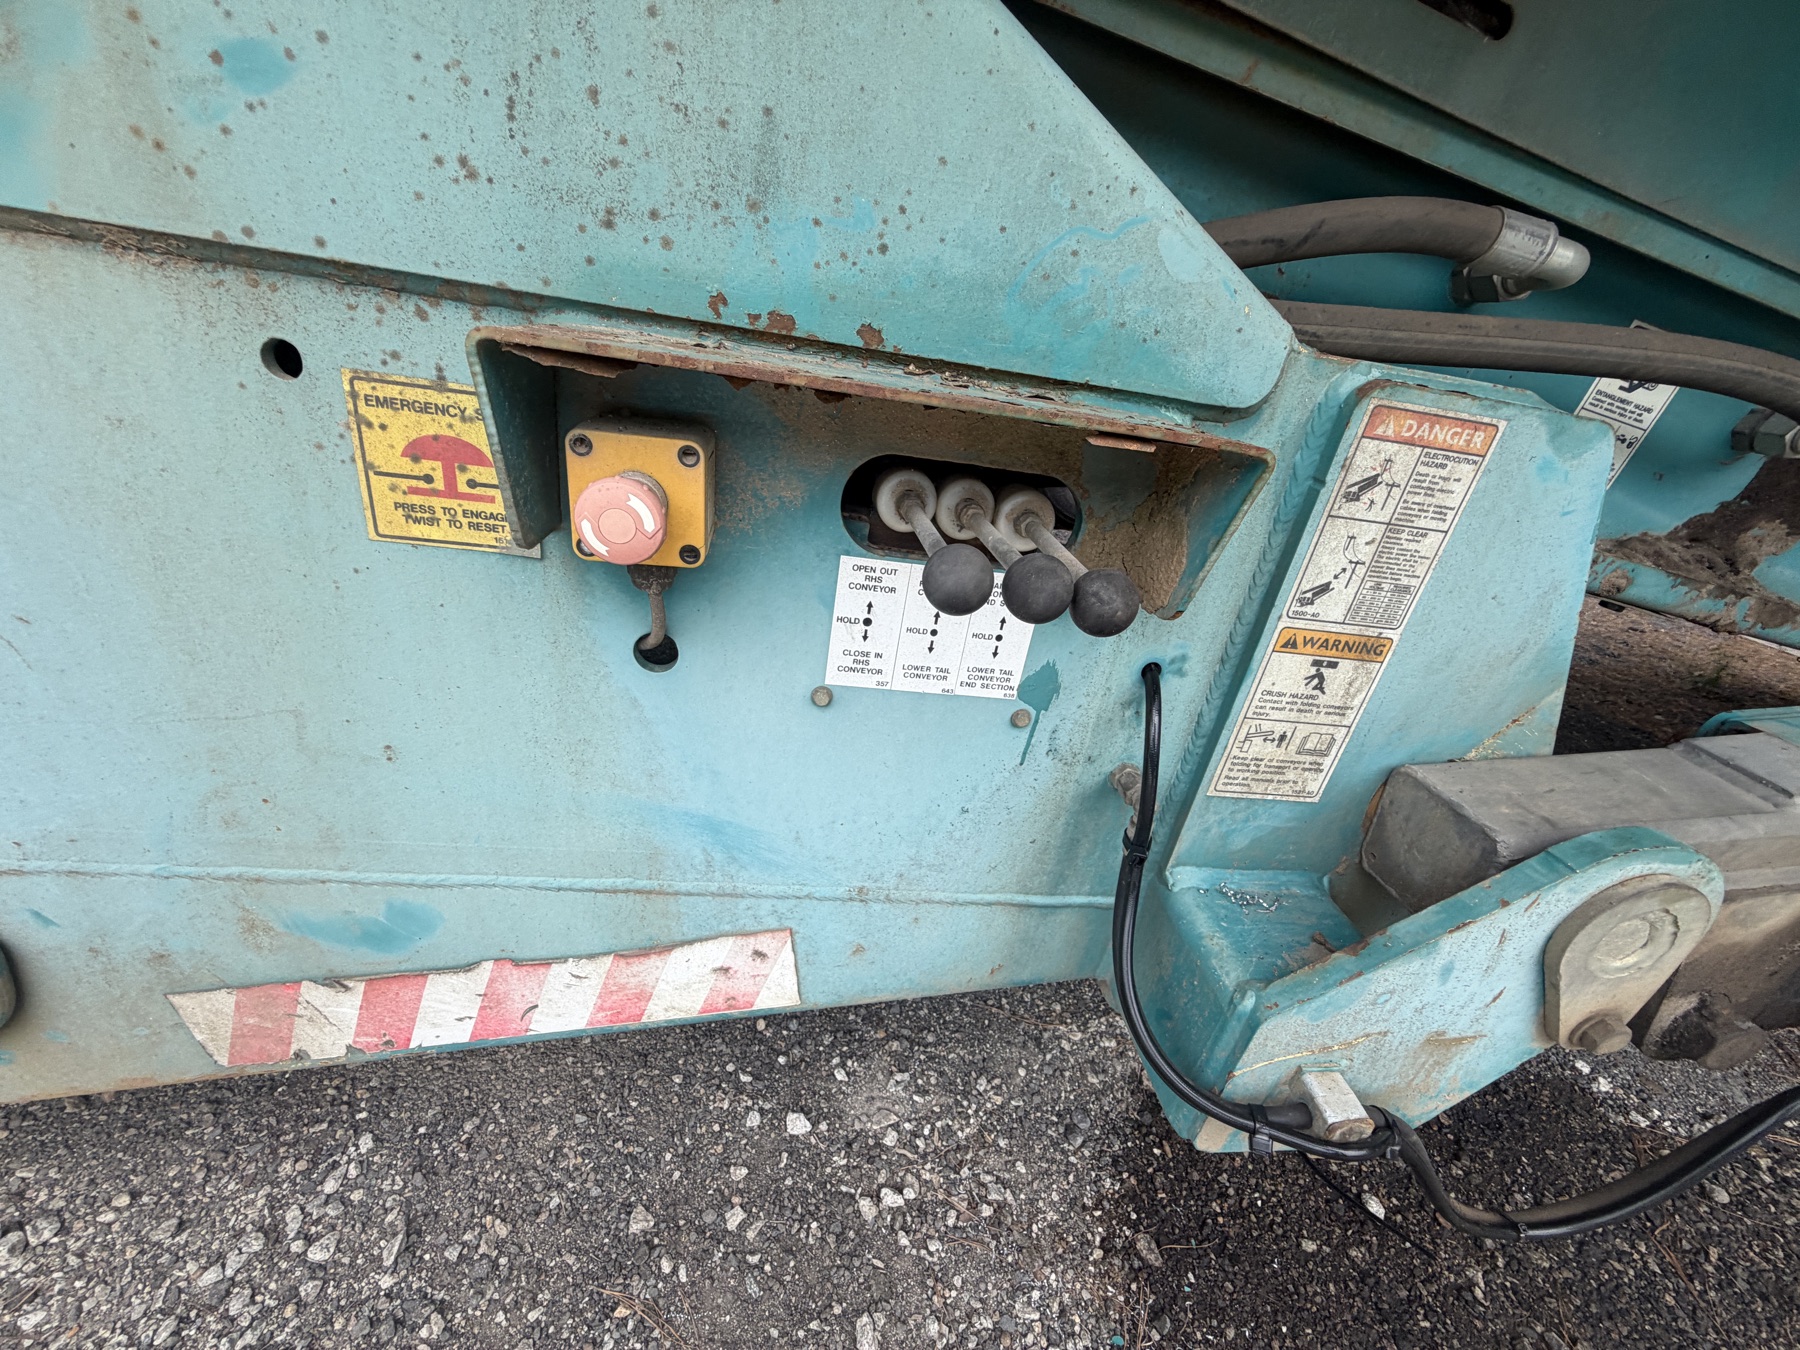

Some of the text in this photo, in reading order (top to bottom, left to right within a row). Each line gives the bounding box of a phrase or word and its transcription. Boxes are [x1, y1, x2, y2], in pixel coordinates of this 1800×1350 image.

[364, 393, 467, 418] EMERGENCY
[1400, 419, 1485, 449] DANGER
[1423, 451, 1479, 466] ELECTROCUTION
[1420, 460, 1448, 470] HAZARD
[394, 502, 507, 522] PRESS TO ENGAG
[402, 514, 507, 534] TWIST TO RESET
[1407, 530, 1428, 538] CLEAR
[852, 564, 898, 576] OPEN OUT
[864, 575, 883, 583] RHS
[848, 582, 897, 594] CONVEYOR
[836, 616, 860, 625] HOLD
[906, 627, 928, 635] HOLD
[972, 632, 993, 641] HOLD
[1302, 635, 1387, 657] WARNING
[842, 649, 871, 658] CLOSE
[852, 658, 870, 666] RHS
[837, 665, 883, 675] CONVEYOR
[902, 664, 931, 672] LOWER
[967, 666, 996, 675] LOWER
[903, 672, 948, 682] CONVEYOR
[967, 674, 1011, 683] CONVEYOR
[980, 683, 1015, 692] SECTION
[1261, 689, 1320, 701] CRUSH HAZARD
[1299, 701, 1321, 709] folding
